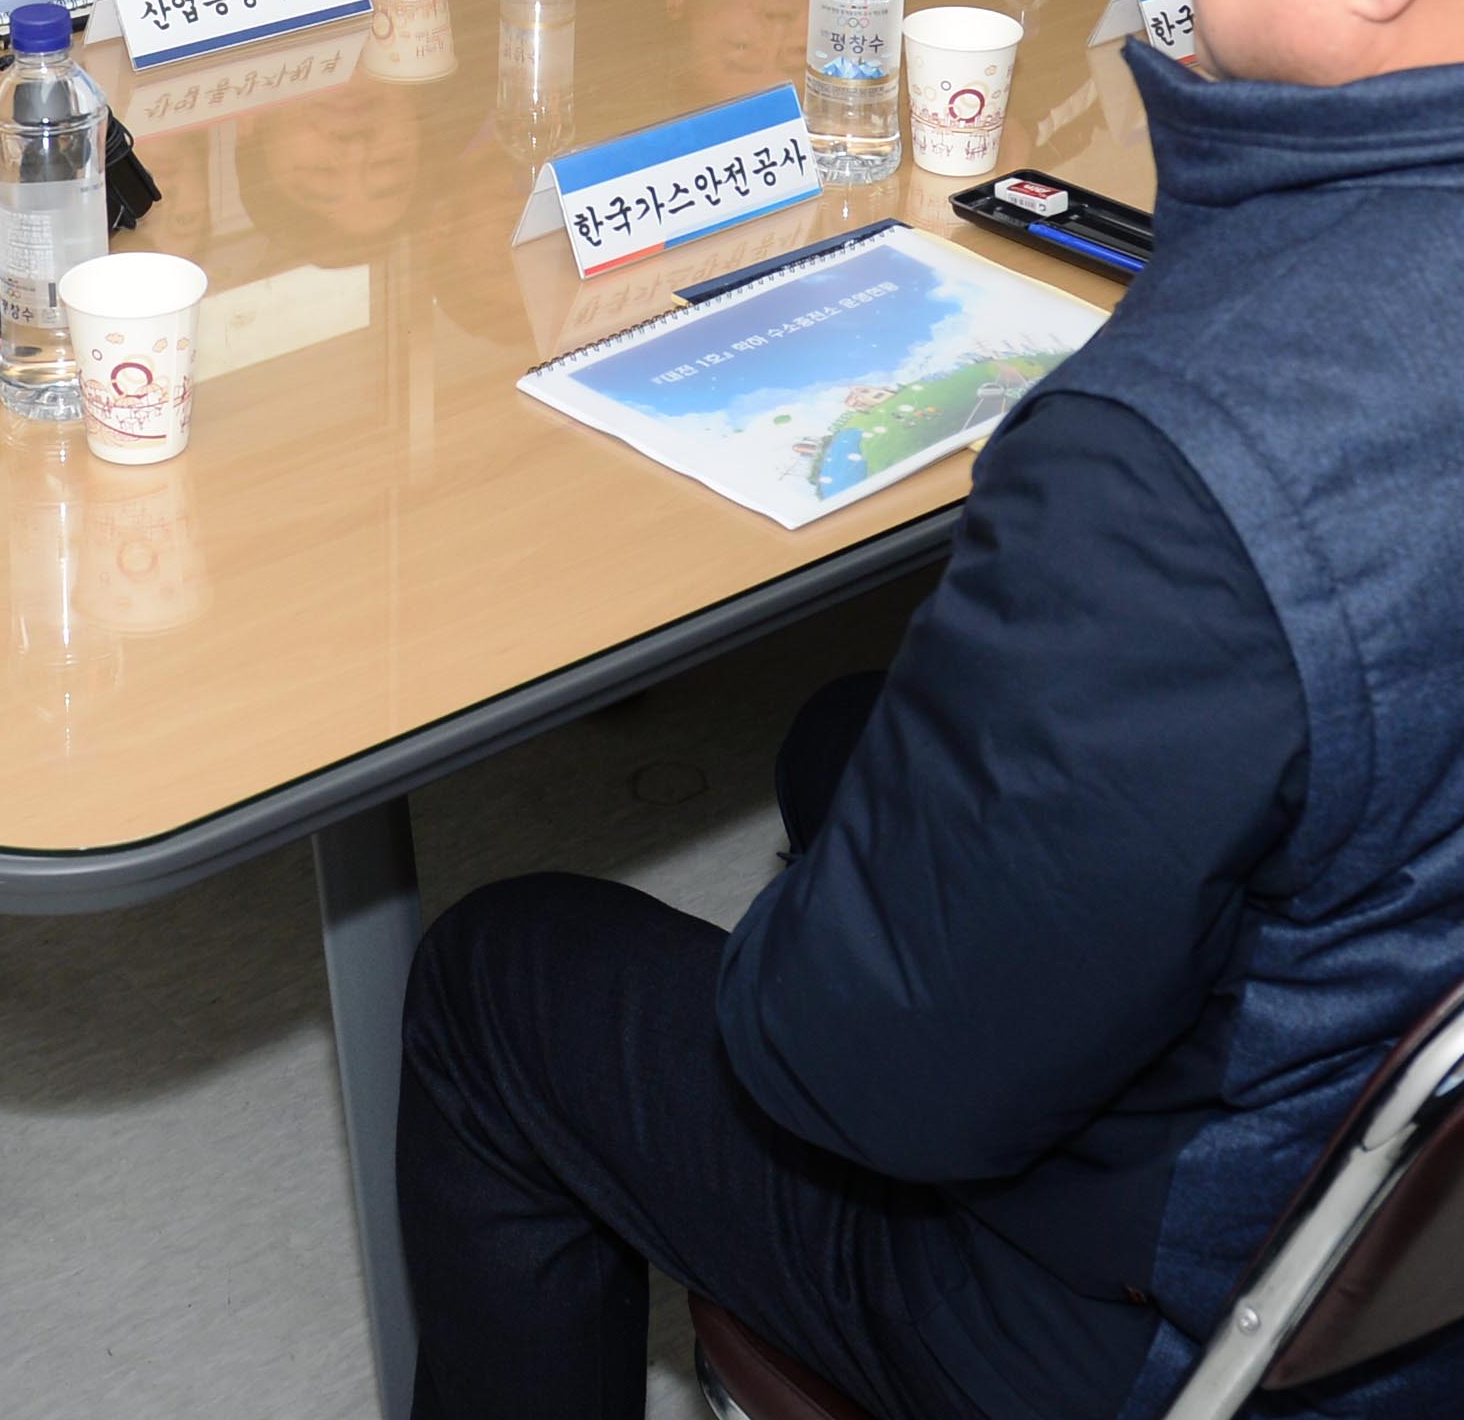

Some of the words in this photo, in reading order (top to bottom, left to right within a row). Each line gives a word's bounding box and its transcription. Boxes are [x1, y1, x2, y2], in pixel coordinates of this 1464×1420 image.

[830, 32, 884, 54] 평창수
[574, 138, 806, 247] 한국가스안전공사
[767, 306, 842, 339] 수소충전소
